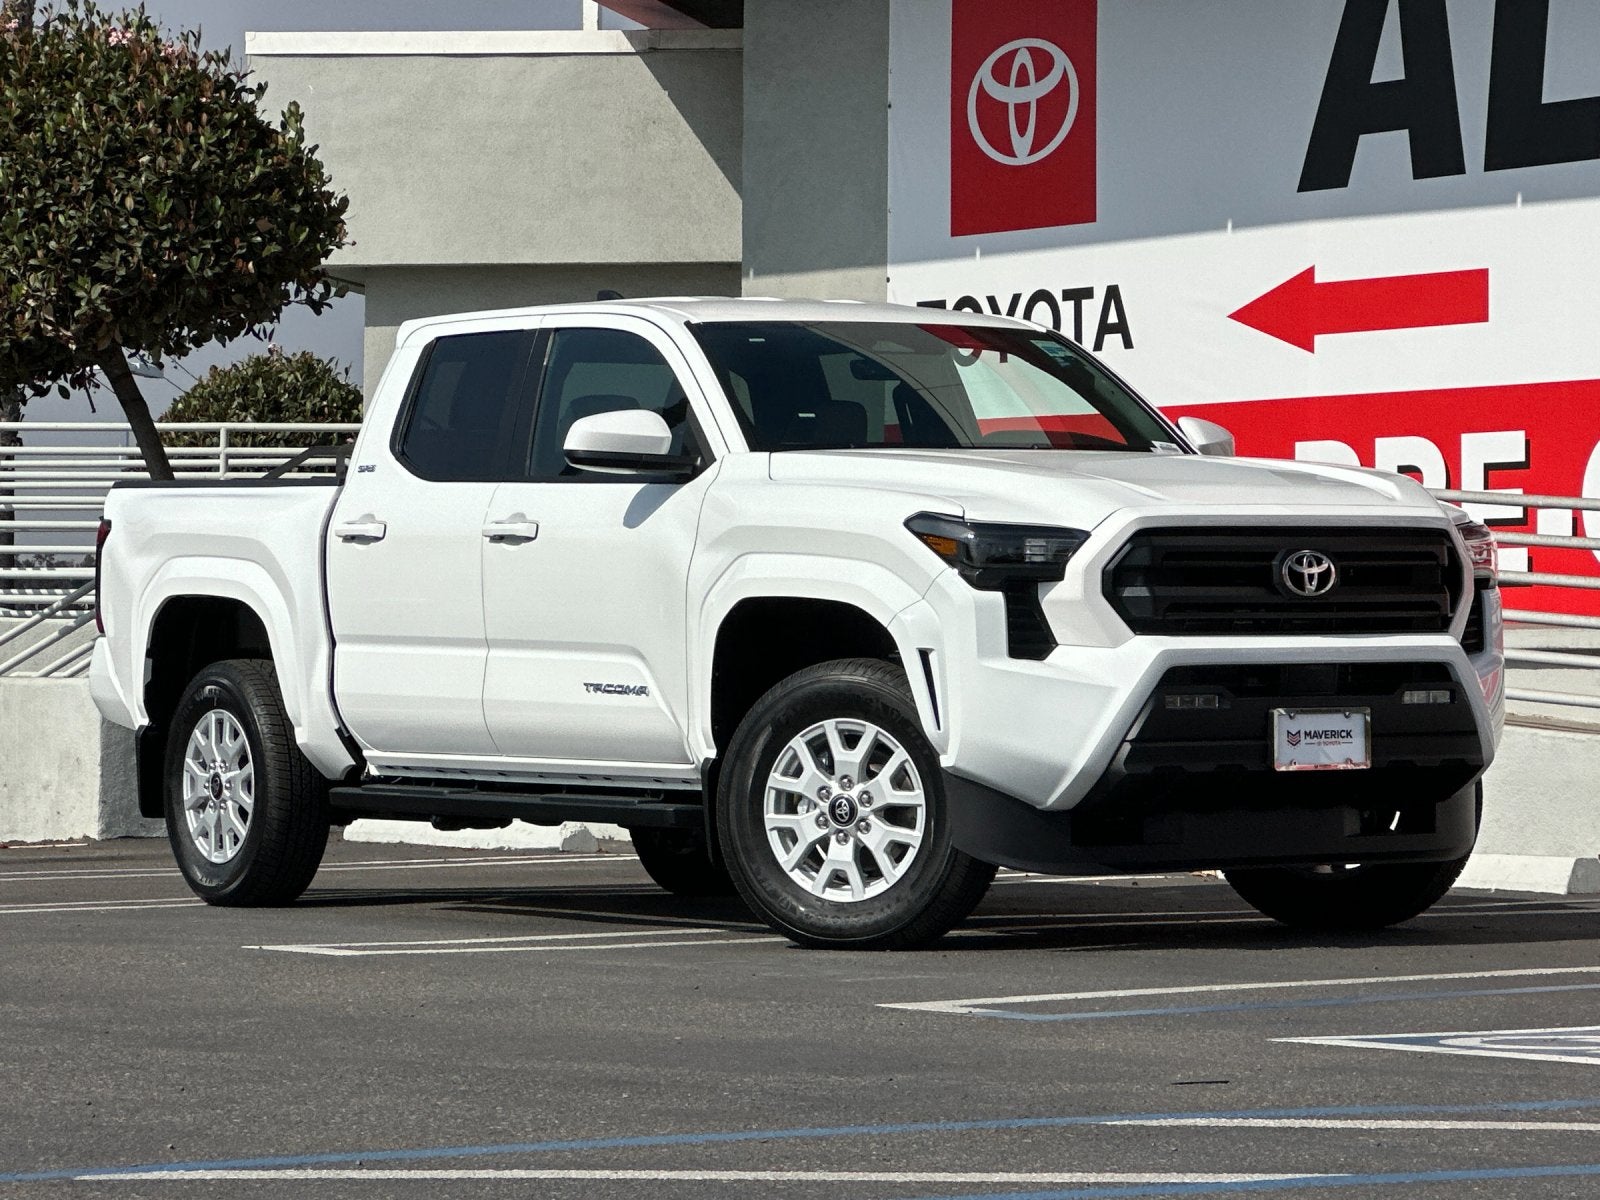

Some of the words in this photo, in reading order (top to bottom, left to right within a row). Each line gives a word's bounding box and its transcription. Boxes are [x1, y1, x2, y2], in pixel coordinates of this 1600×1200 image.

[916, 284, 1134, 366] OYOTA
[583, 682, 650, 696] TACOMA
[1304, 729, 1353, 740] MAVERICK
